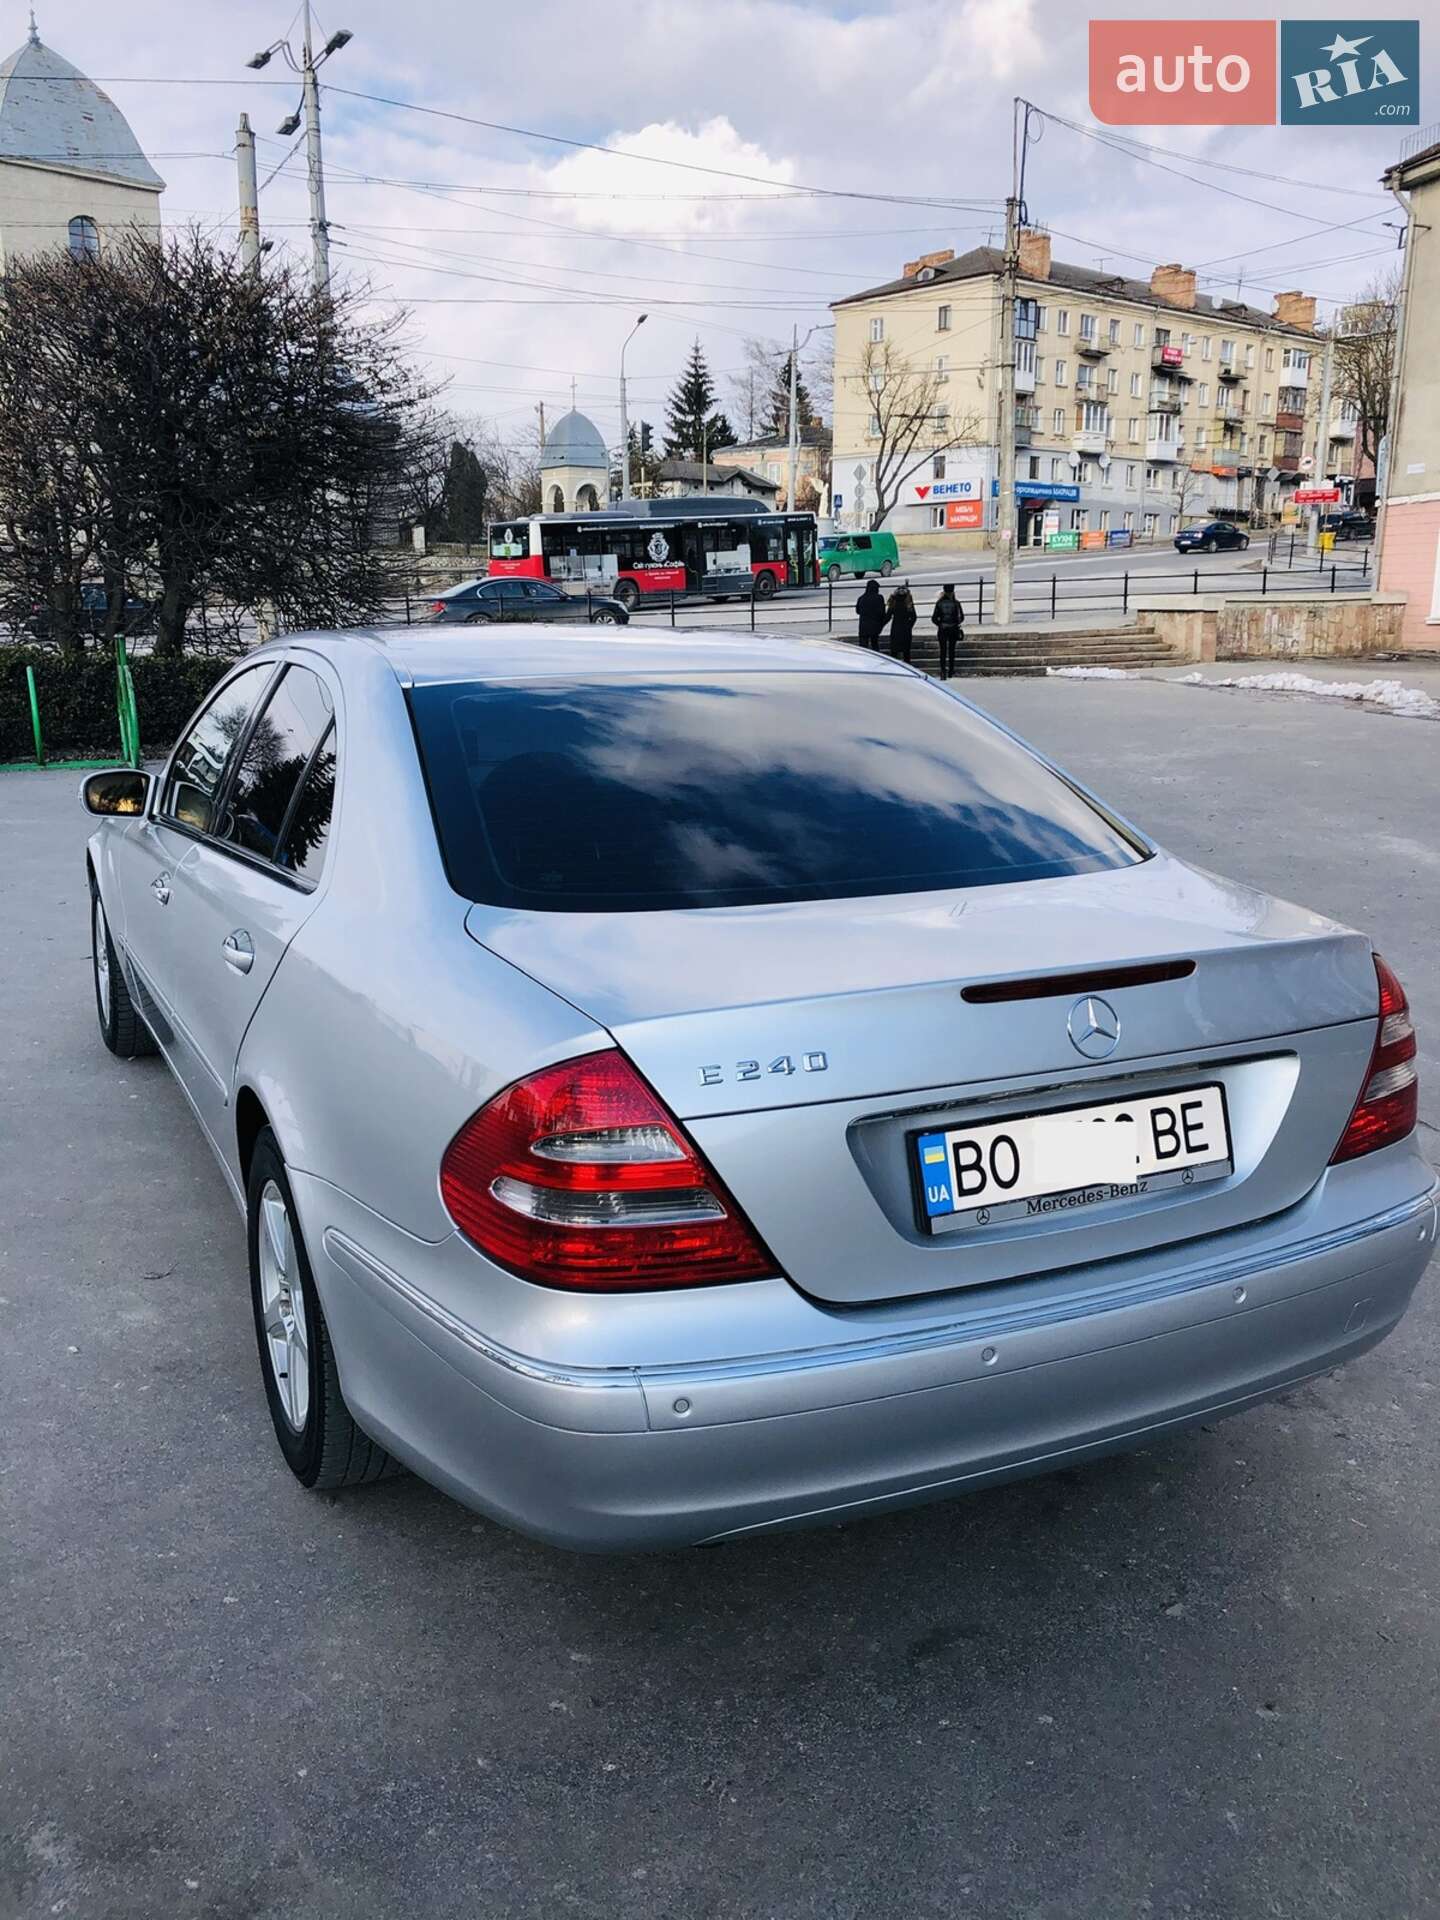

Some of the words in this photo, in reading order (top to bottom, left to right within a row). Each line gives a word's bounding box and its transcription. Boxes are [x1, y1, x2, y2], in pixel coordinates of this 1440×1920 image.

[933, 482, 972, 495] ВЕНЕТО
[698, 1064, 724, 1087] E
[736, 1051, 829, 1082] 240
[928, 1186, 951, 1202] UA
[1026, 1180, 1149, 1215] Mercedes-Benz
